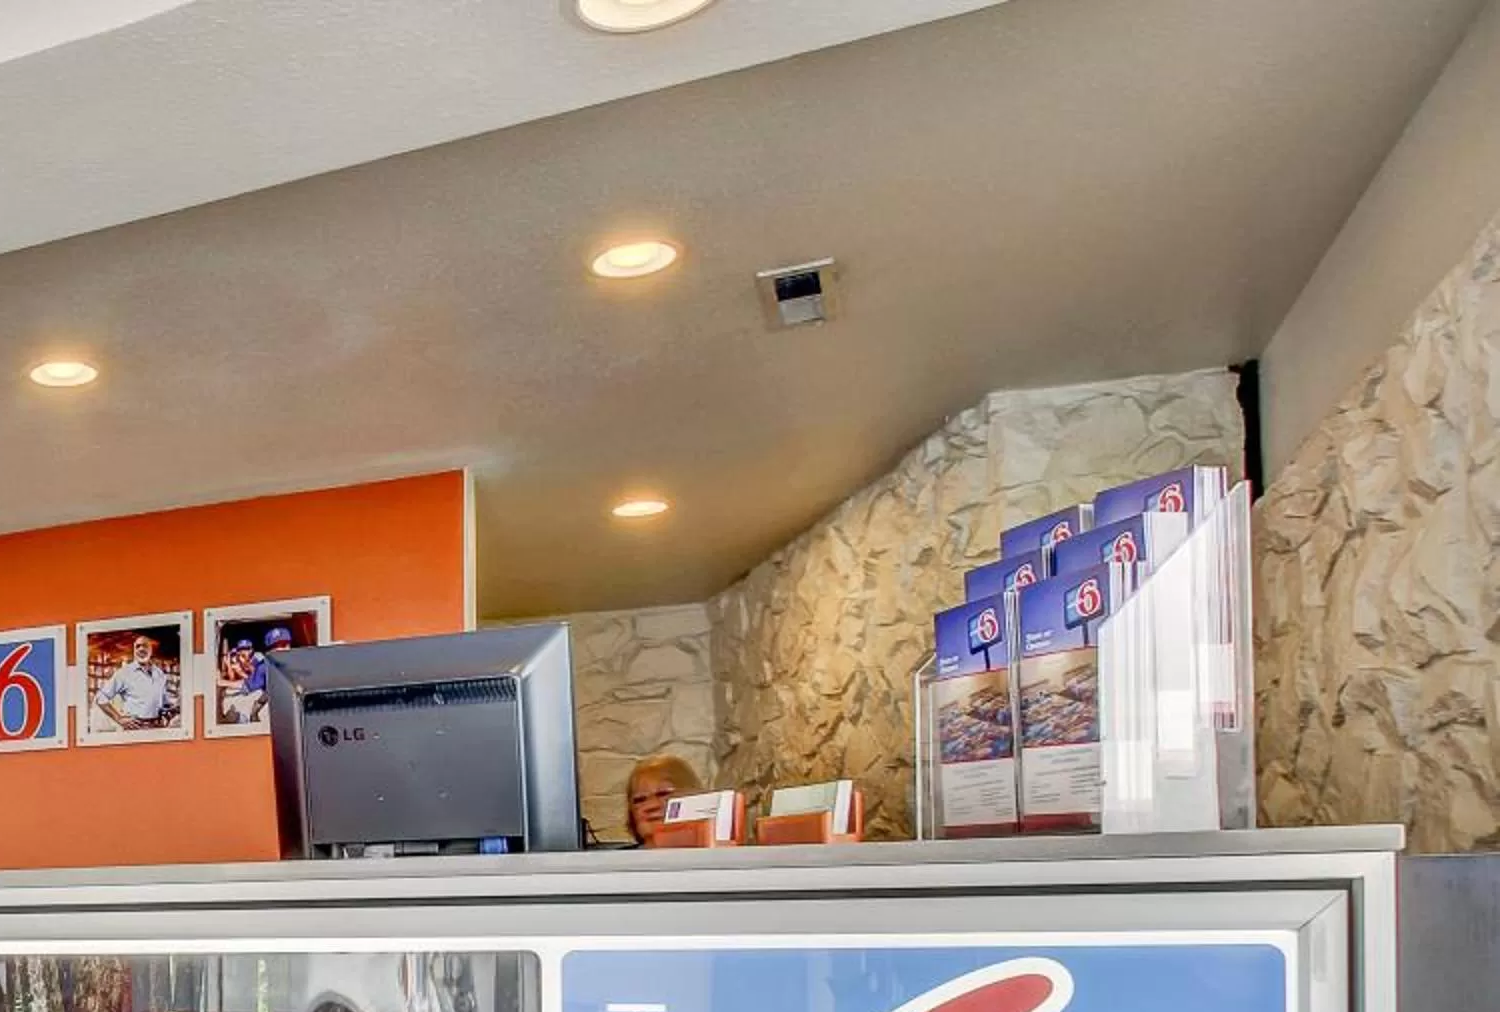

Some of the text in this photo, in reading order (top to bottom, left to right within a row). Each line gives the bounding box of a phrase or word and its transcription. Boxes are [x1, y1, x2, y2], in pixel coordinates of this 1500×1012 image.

[1077, 579, 1101, 616] 6
[978, 607, 998, 642] 6
[343, 727, 366, 741] LG
